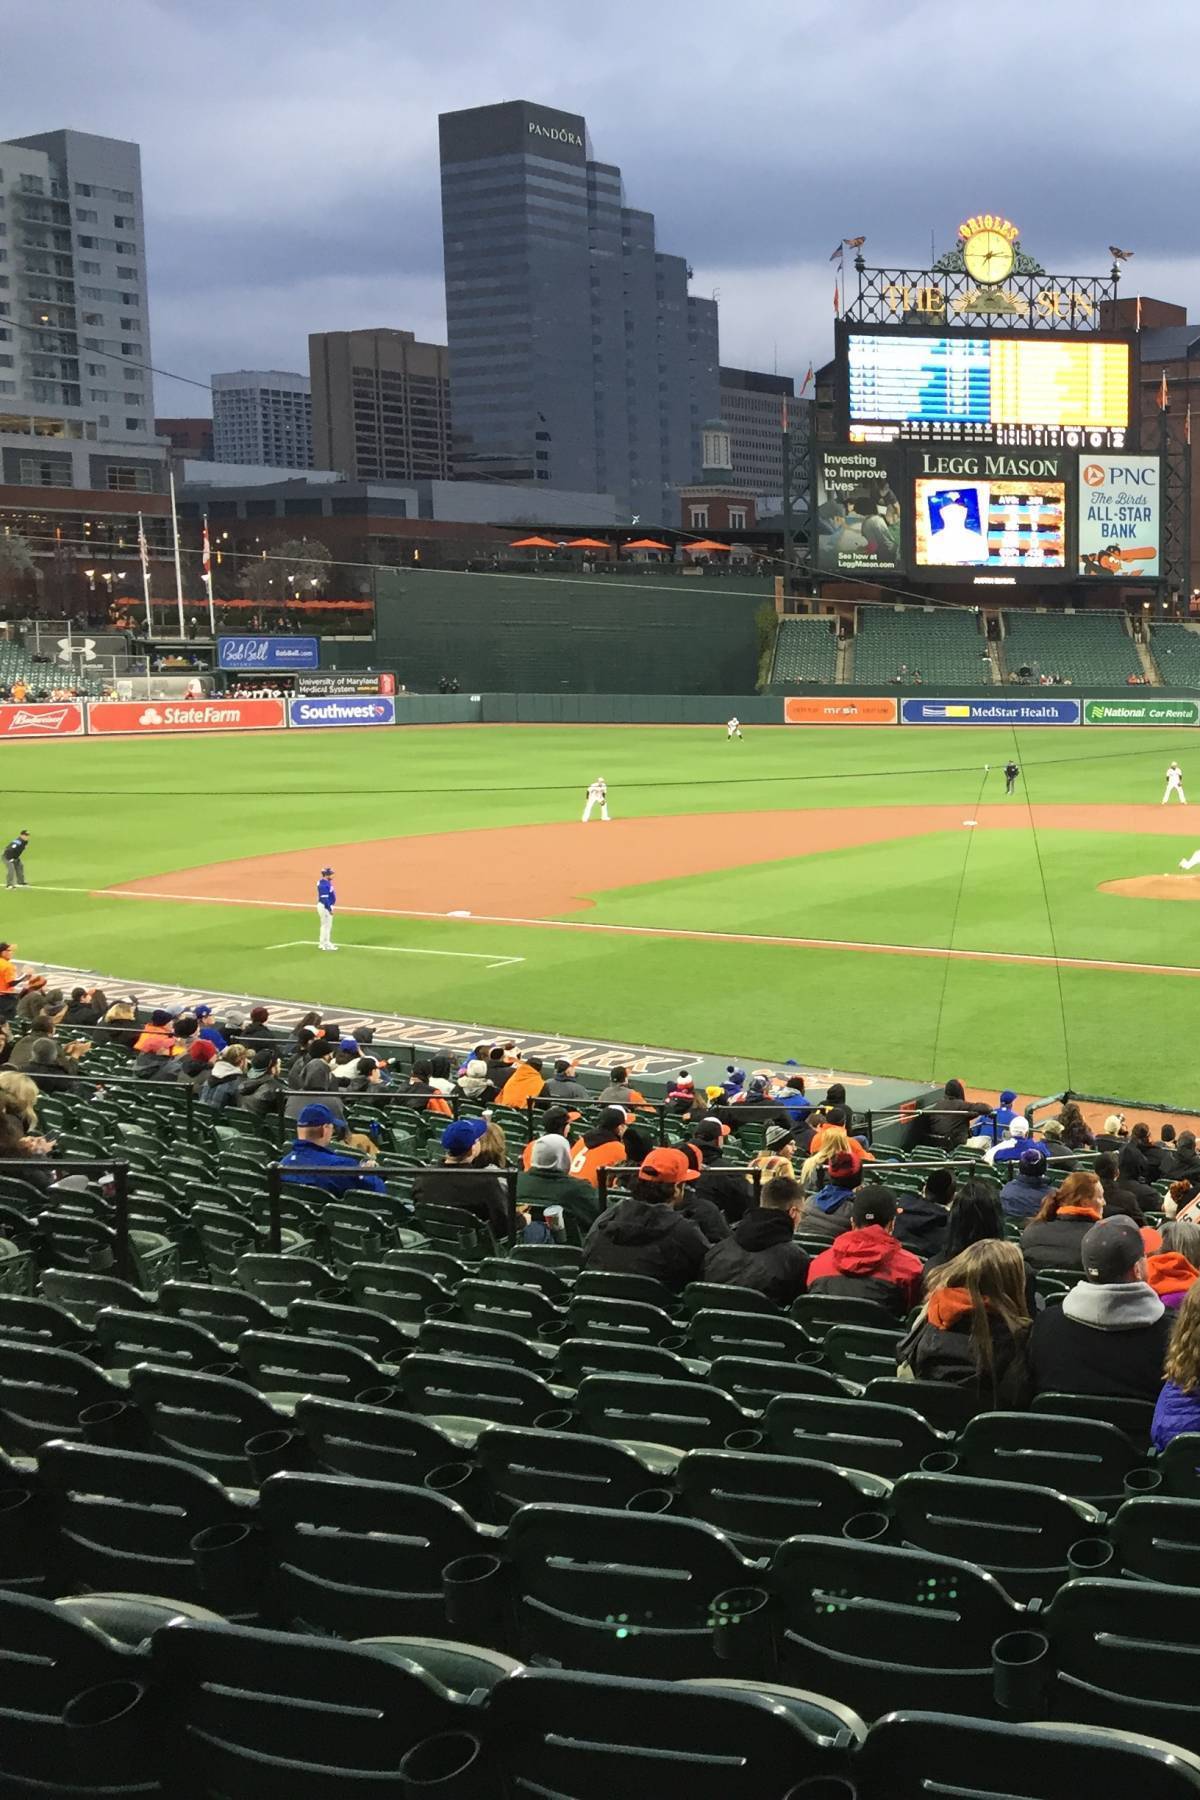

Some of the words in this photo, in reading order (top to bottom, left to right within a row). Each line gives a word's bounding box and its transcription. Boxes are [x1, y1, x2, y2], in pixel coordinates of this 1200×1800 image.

[958, 214, 1019, 240] ORIOLES
[882, 284, 945, 313] THE
[1036, 289, 1093, 318] SUN
[824, 452, 877, 467] Investing
[923, 454, 978, 474] LEGG
[984, 455, 1058, 476] MASON
[824, 467, 836, 477] to
[840, 467, 887, 480] Improve
[1109, 467, 1155, 486] PNC
[1091, 491, 1113, 505] The
[1115, 492, 1147, 505] Birds
[1087, 506, 1151, 522] ALL-STAR
[1101, 523, 1136, 538] BANK
[838, 552, 852, 560] See
[838, 560, 895, 568] LeggMason.com
[223, 640, 244, 661] Bob
[245, 640, 268, 661] Bell
[275, 649, 313, 658] BobBell.com
[299, 677, 335, 687] University
[337, 677, 345, 685] of
[346, 677, 379, 687] Maryland
[299, 686, 327, 694] Medical
[329, 685, 355, 694] System
[300, 704, 375, 719] Southwest
[971, 706, 1018, 718] MedStar
[1021, 706, 1059, 718] Health
[1103, 707, 1146, 718] National
[1150, 708, 1164, 718] Car
[1166, 709, 1194, 718] Rental
[535, 1041, 683, 1072] PARK
